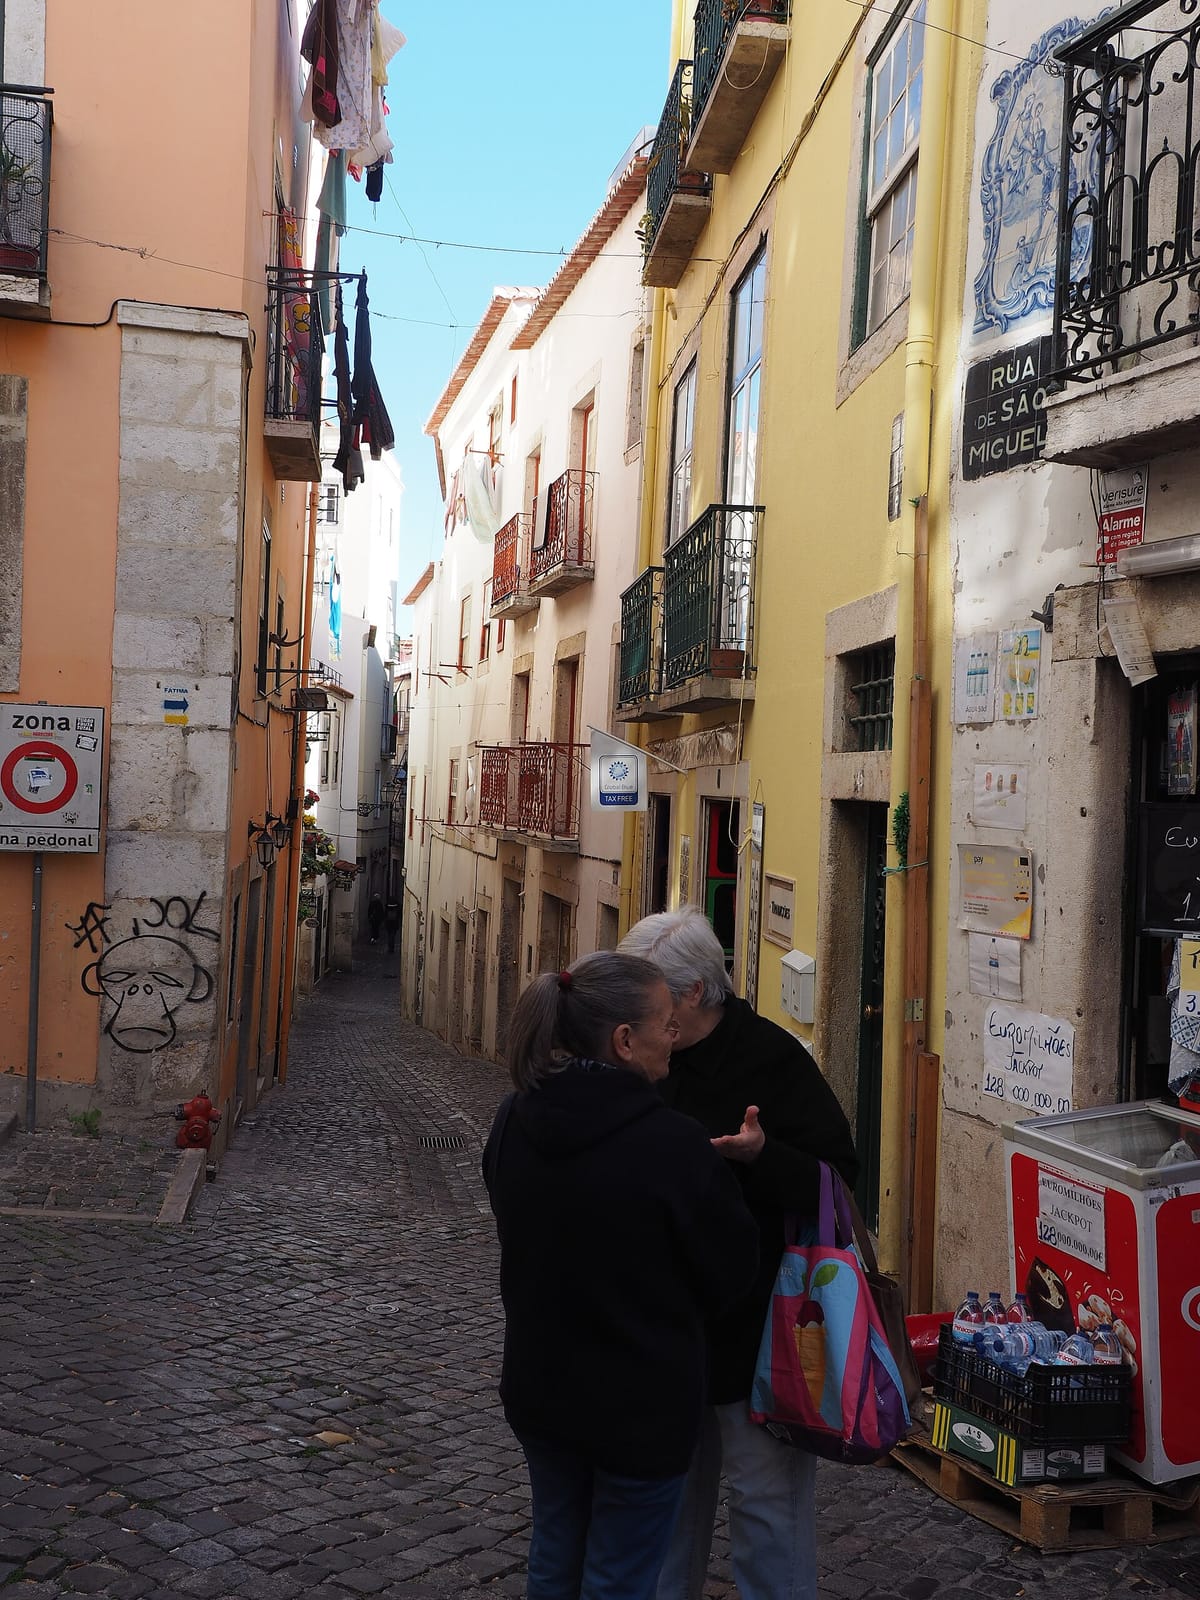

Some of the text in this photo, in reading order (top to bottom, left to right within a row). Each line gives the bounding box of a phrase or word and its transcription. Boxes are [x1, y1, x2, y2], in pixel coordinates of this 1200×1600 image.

[991, 355, 1035, 391] RUA
[977, 387, 1047, 430] DE SÃO
[968, 425, 1046, 466] MIGUEL
[1102, 484, 1144, 502] verisure
[1102, 515, 1141, 532] Alarme
[12, 714, 70, 731] zona
[26, 834, 93, 848] pedonal
[1005, 1054, 1044, 1079] JACKPOT
[984, 1073, 1004, 1098] 128
[1041, 1177, 1103, 1213] EUROMILHÕES
[1050, 1204, 1093, 1233] JACKPOT
